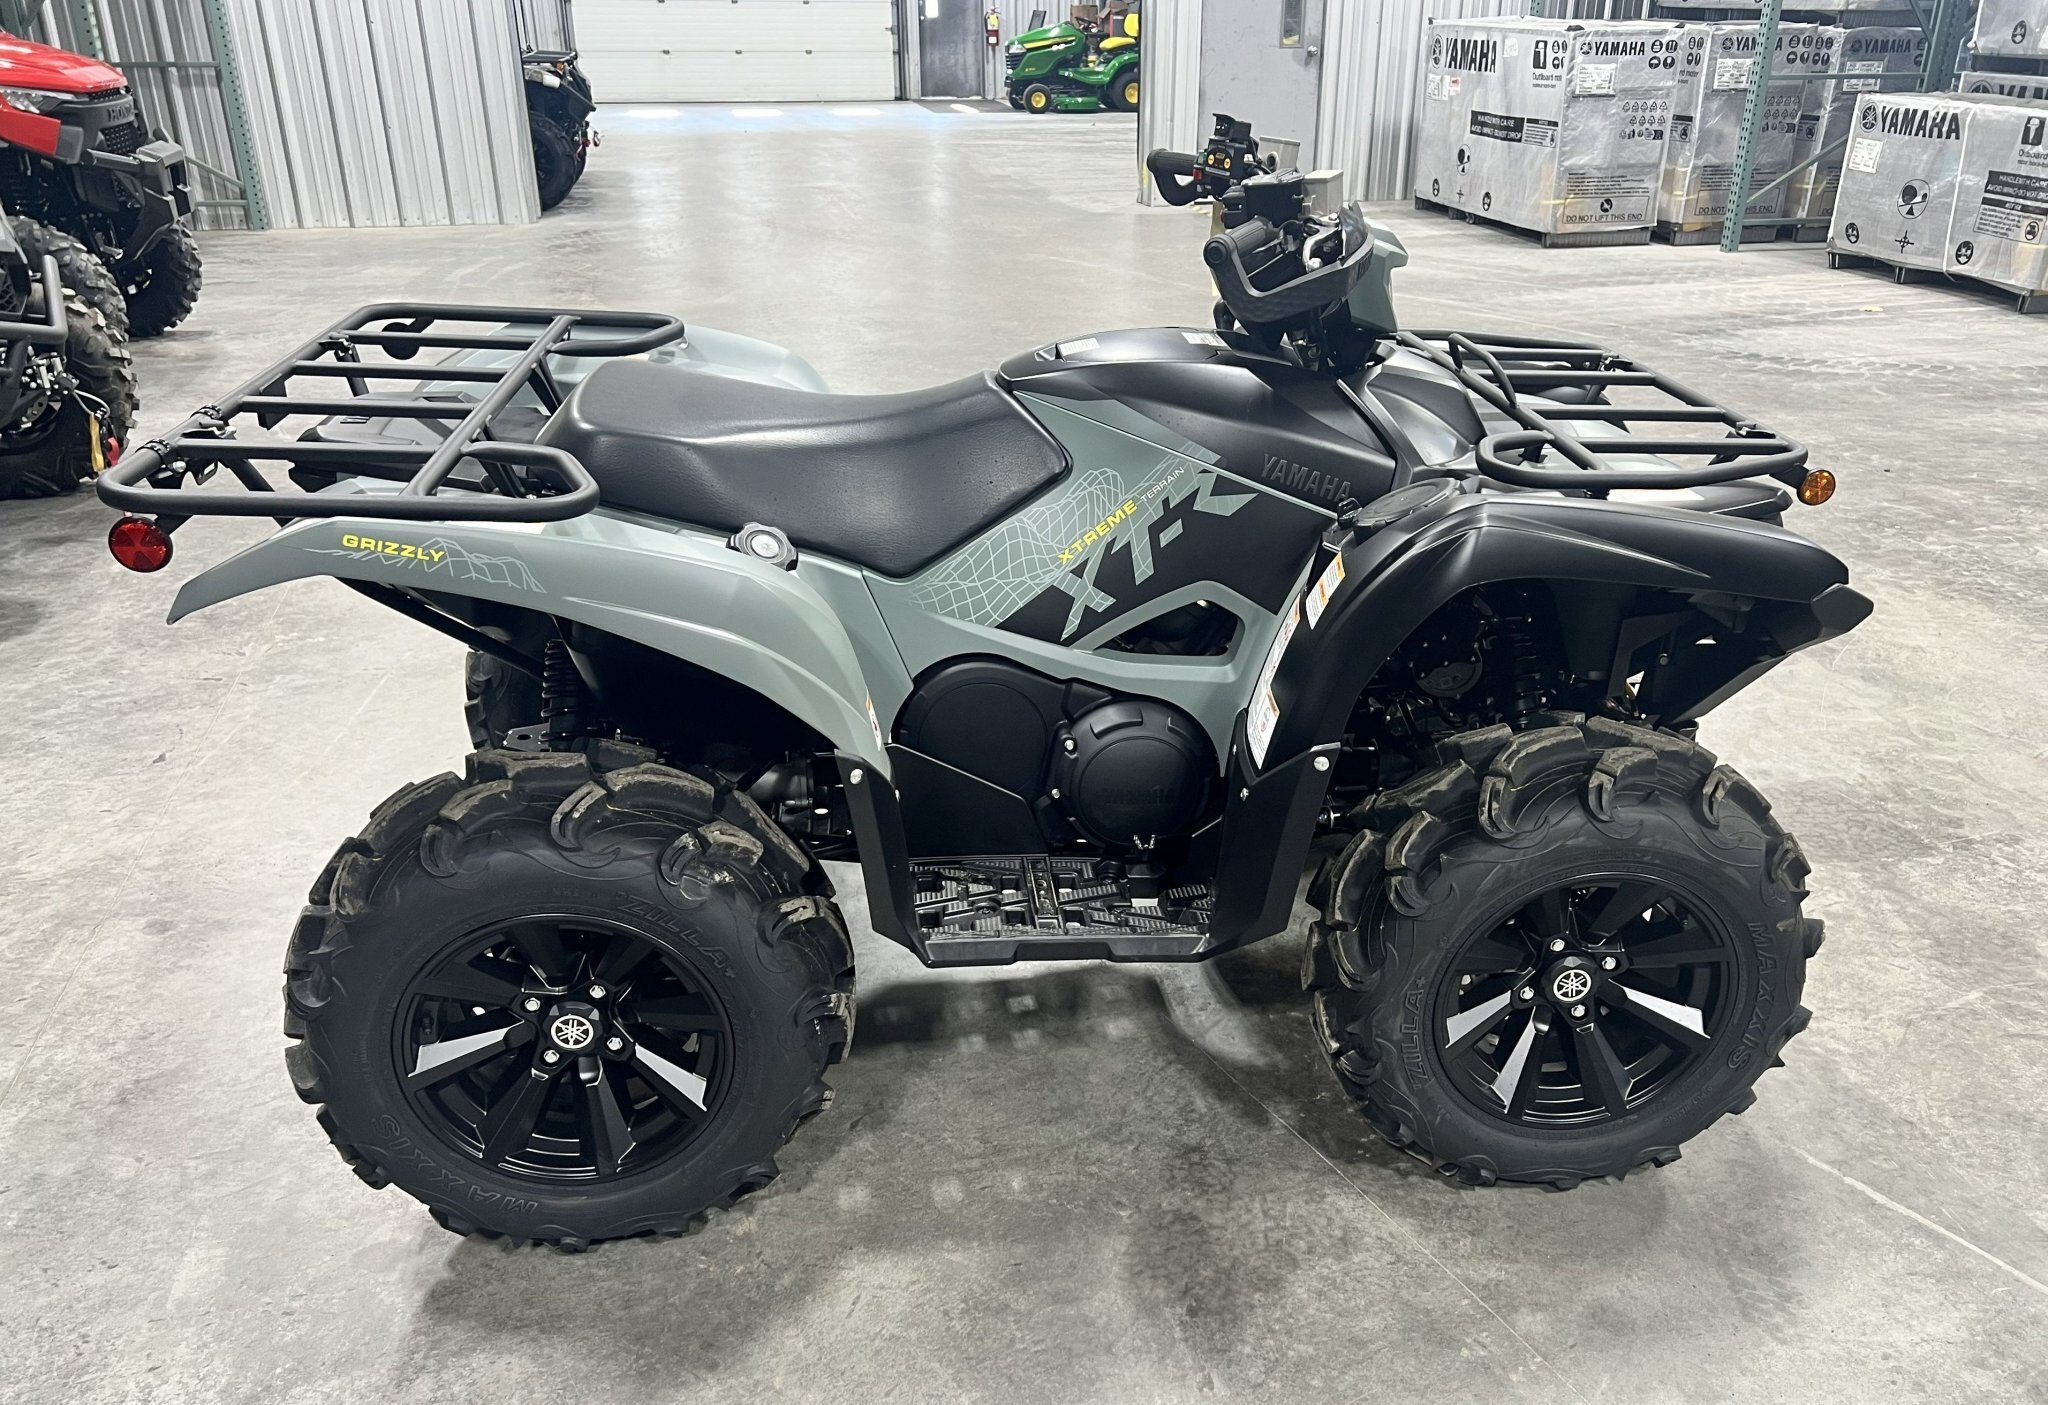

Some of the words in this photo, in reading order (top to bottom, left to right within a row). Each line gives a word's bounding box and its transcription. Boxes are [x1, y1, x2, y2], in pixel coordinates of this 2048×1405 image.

[1445, 38, 1496, 73] YAMAHA
[1594, 41, 1645, 56] YAMAHA
[1736, 36, 1782, 51] YAMA
[1865, 39, 1911, 53] YAMAHA
[107, 103, 132, 122] HON
[1880, 106, 1960, 140] YAMAHA
[1711, 206, 1726, 214] NOT
[1261, 453, 1351, 502] YAMAHA
[1058, 499, 1138, 565] XTREME
[1140, 466, 1185, 502] TERRAIN
[342, 534, 445, 562] GRIZZLY
[1727, 921, 1776, 1069] MAXXIS
[1400, 990, 1428, 1084] ZILLA
[371, 1114, 538, 1215] MAXXIS
